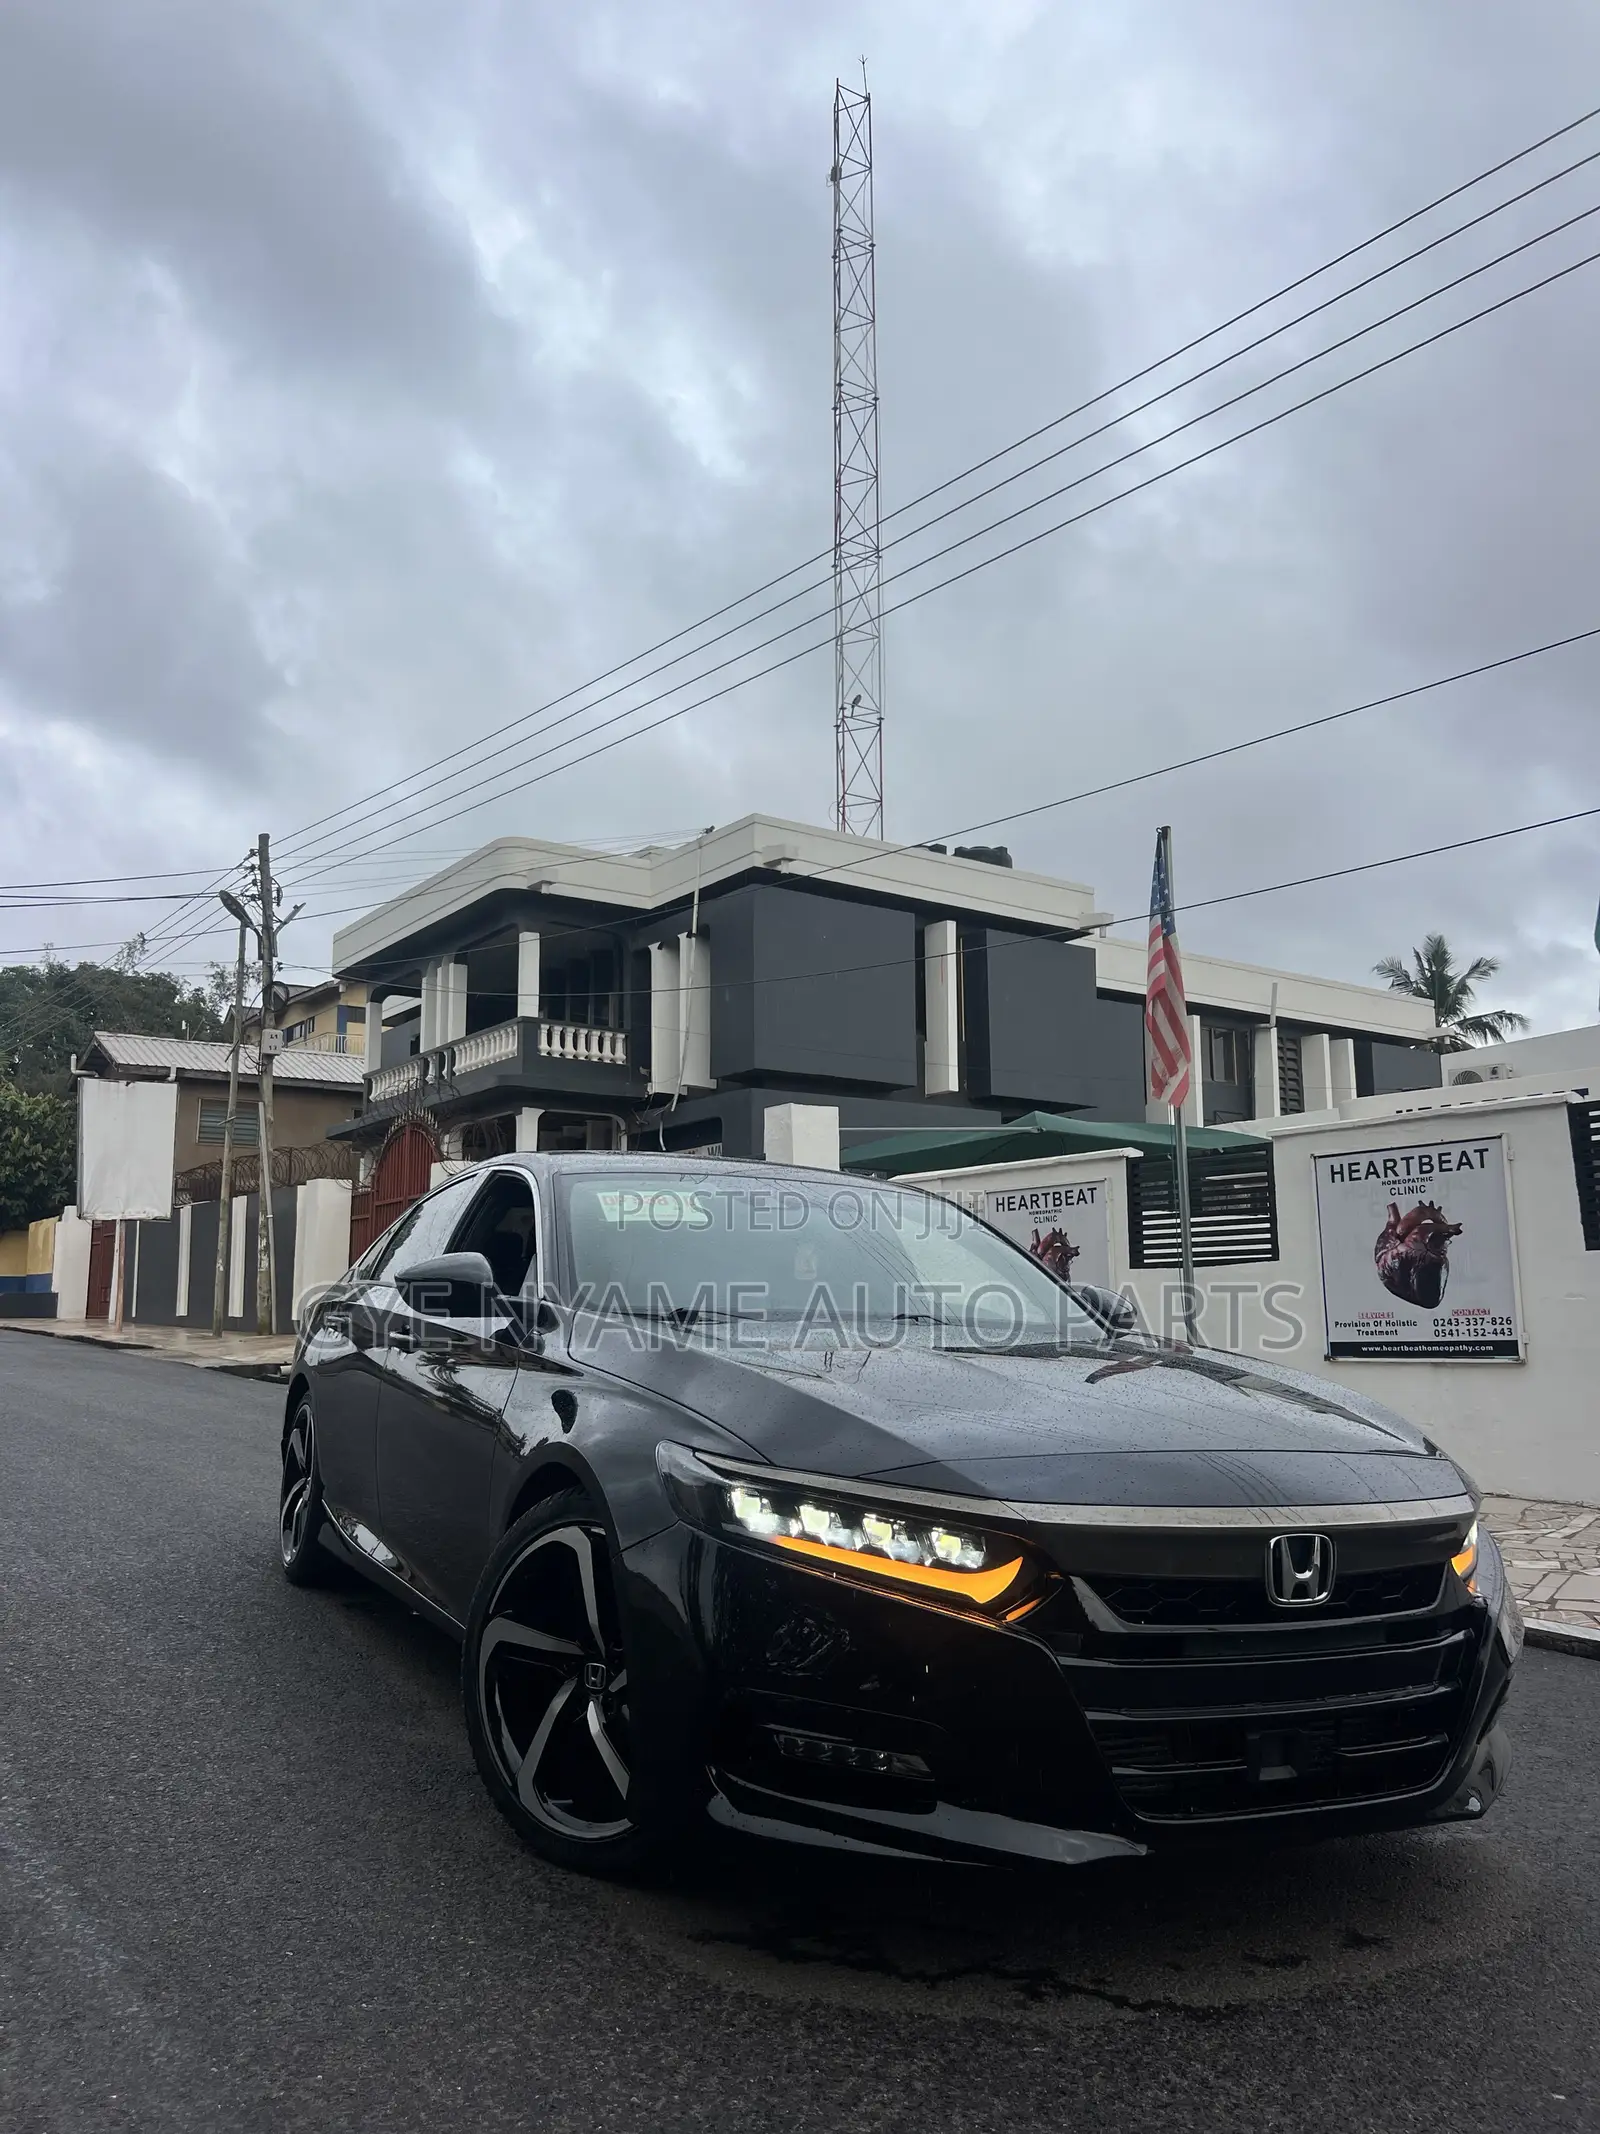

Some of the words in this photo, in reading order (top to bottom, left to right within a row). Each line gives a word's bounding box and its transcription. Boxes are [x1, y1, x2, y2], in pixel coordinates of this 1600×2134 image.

[1330, 1148, 1489, 1183] HEARTBEAT
[1381, 1176, 1434, 1186] HOMEOPATHIC
[1389, 1184, 1426, 1196] CLINIC
[995, 1187, 1098, 1212] HEARTBEAT
[1033, 1214, 1058, 1224] CLINIC
[1452, 1308, 1491, 1316] CONTACT
[1334, 1320, 1371, 1328] Provision
[1432, 1316, 1512, 1327] 0243-337-826
[1433, 1327, 1513, 1338] 0541-152-443
[1361, 1344, 1494, 1352] www.heartbeathomeopathy.com
